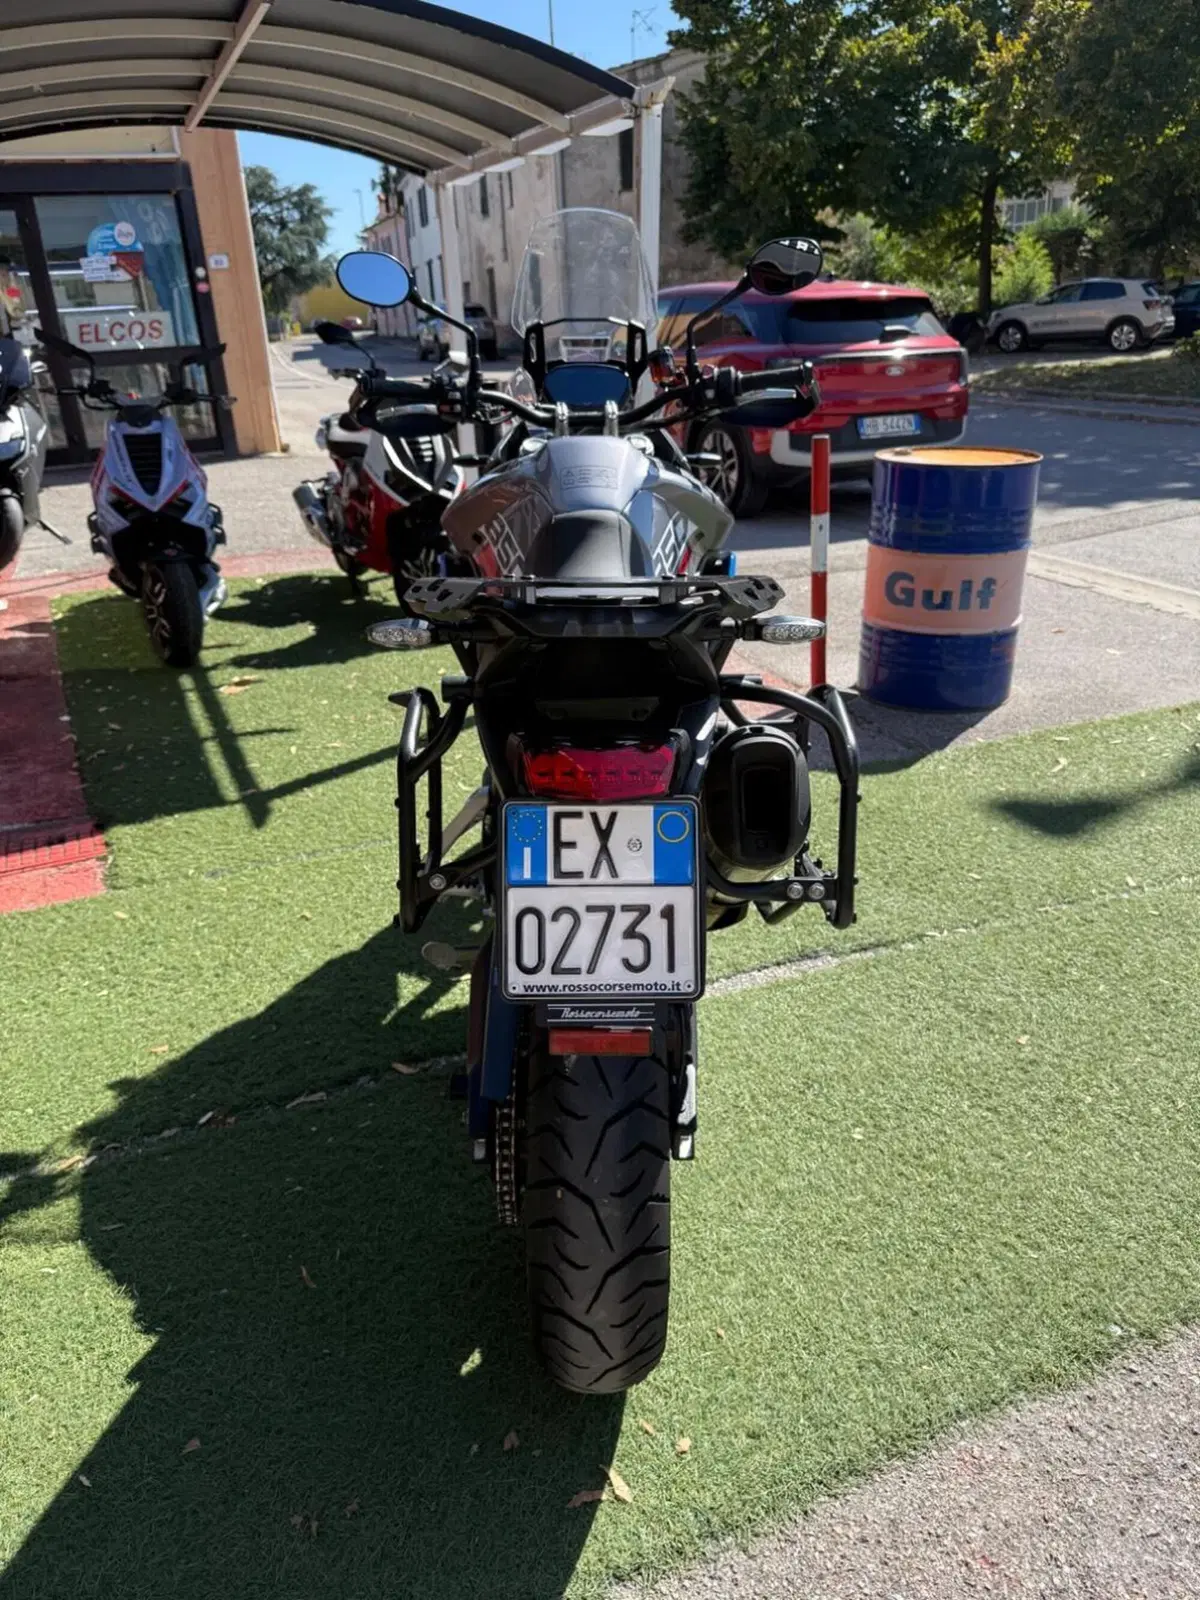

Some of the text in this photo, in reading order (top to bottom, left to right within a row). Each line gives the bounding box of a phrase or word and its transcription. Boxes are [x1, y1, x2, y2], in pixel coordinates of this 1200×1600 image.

[77, 319, 164, 344] ELCOS
[884, 571, 997, 611] Gulf
[553, 811, 619, 879] EX
[515, 904, 675, 975] 02731
[523, 981, 682, 993] www.rossocorsemoto.it
[560, 1007, 641, 1019] Rossocorsemoto
